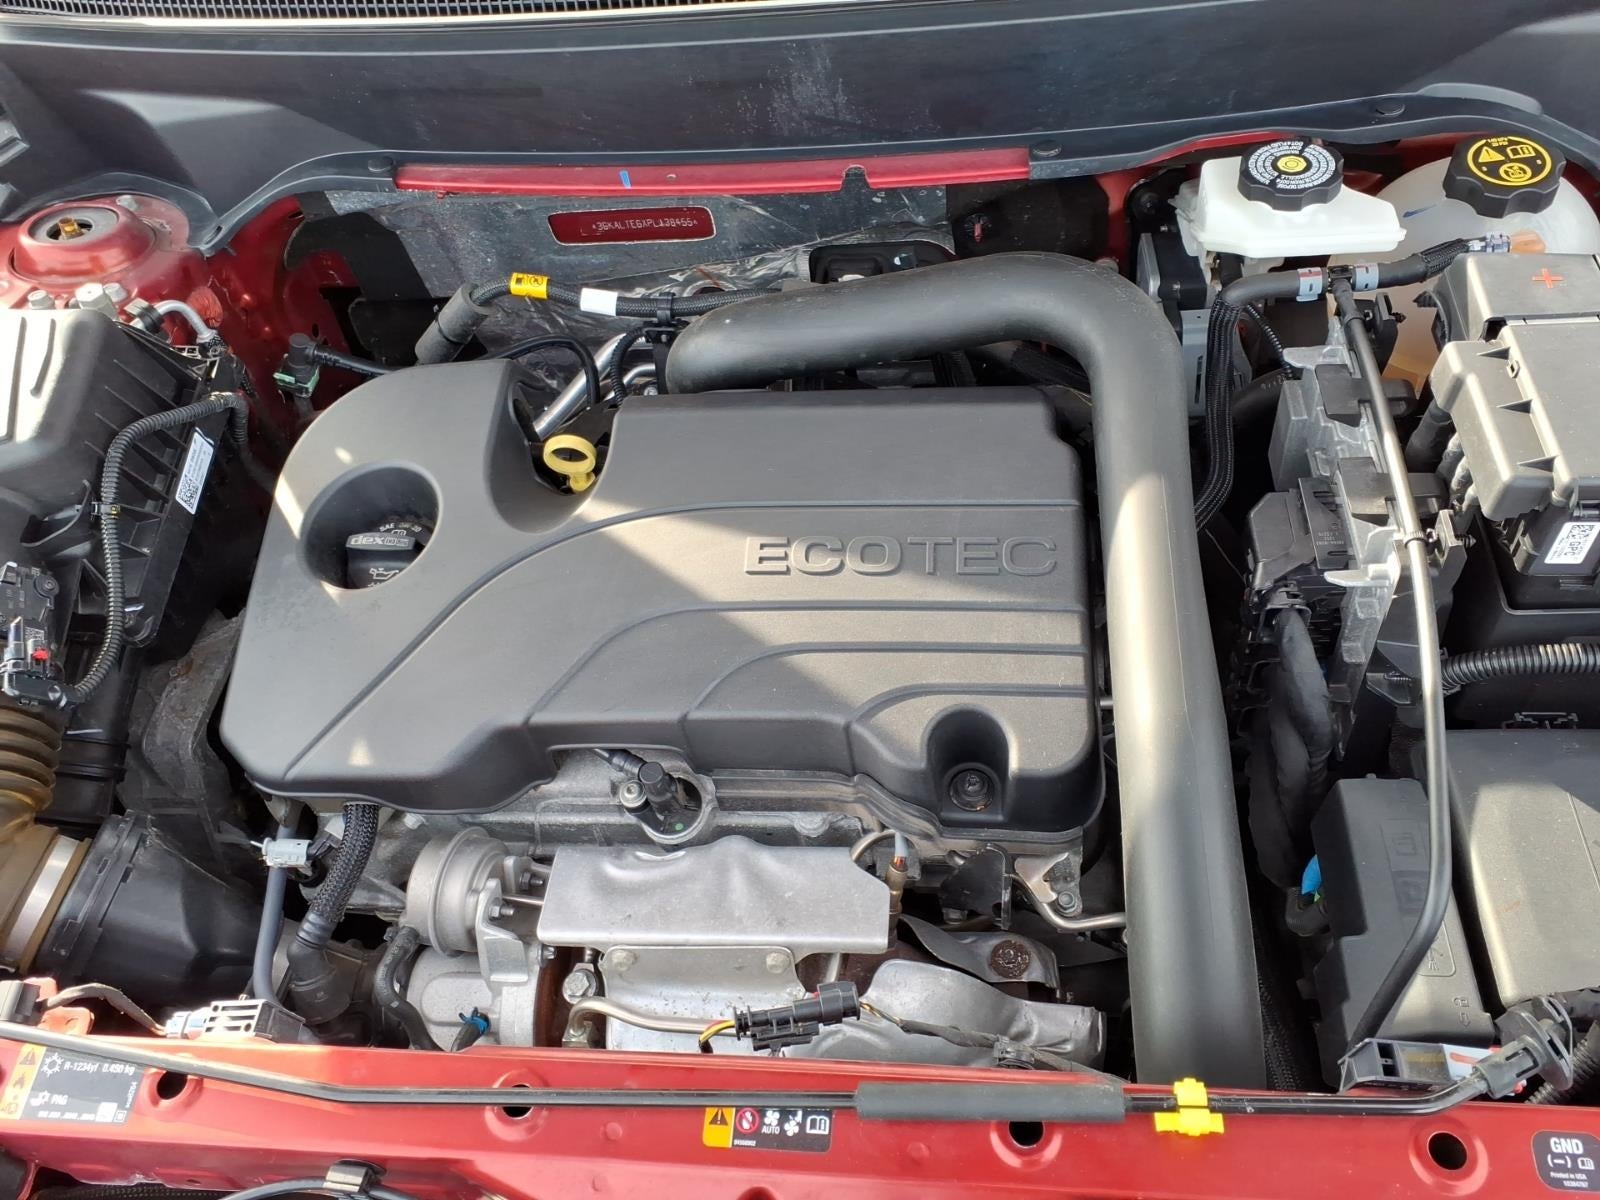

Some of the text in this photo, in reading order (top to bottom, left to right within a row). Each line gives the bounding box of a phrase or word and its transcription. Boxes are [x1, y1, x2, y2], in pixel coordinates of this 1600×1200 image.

[379, 522, 395, 532] SAE
[744, 536, 1057, 576] ECOTEC
[123, 1064, 136, 1076] kg
[50, 1094, 69, 1106] PAG
[761, 1125, 780, 1135] AUTO
[1549, 1136, 1584, 1155] GND
